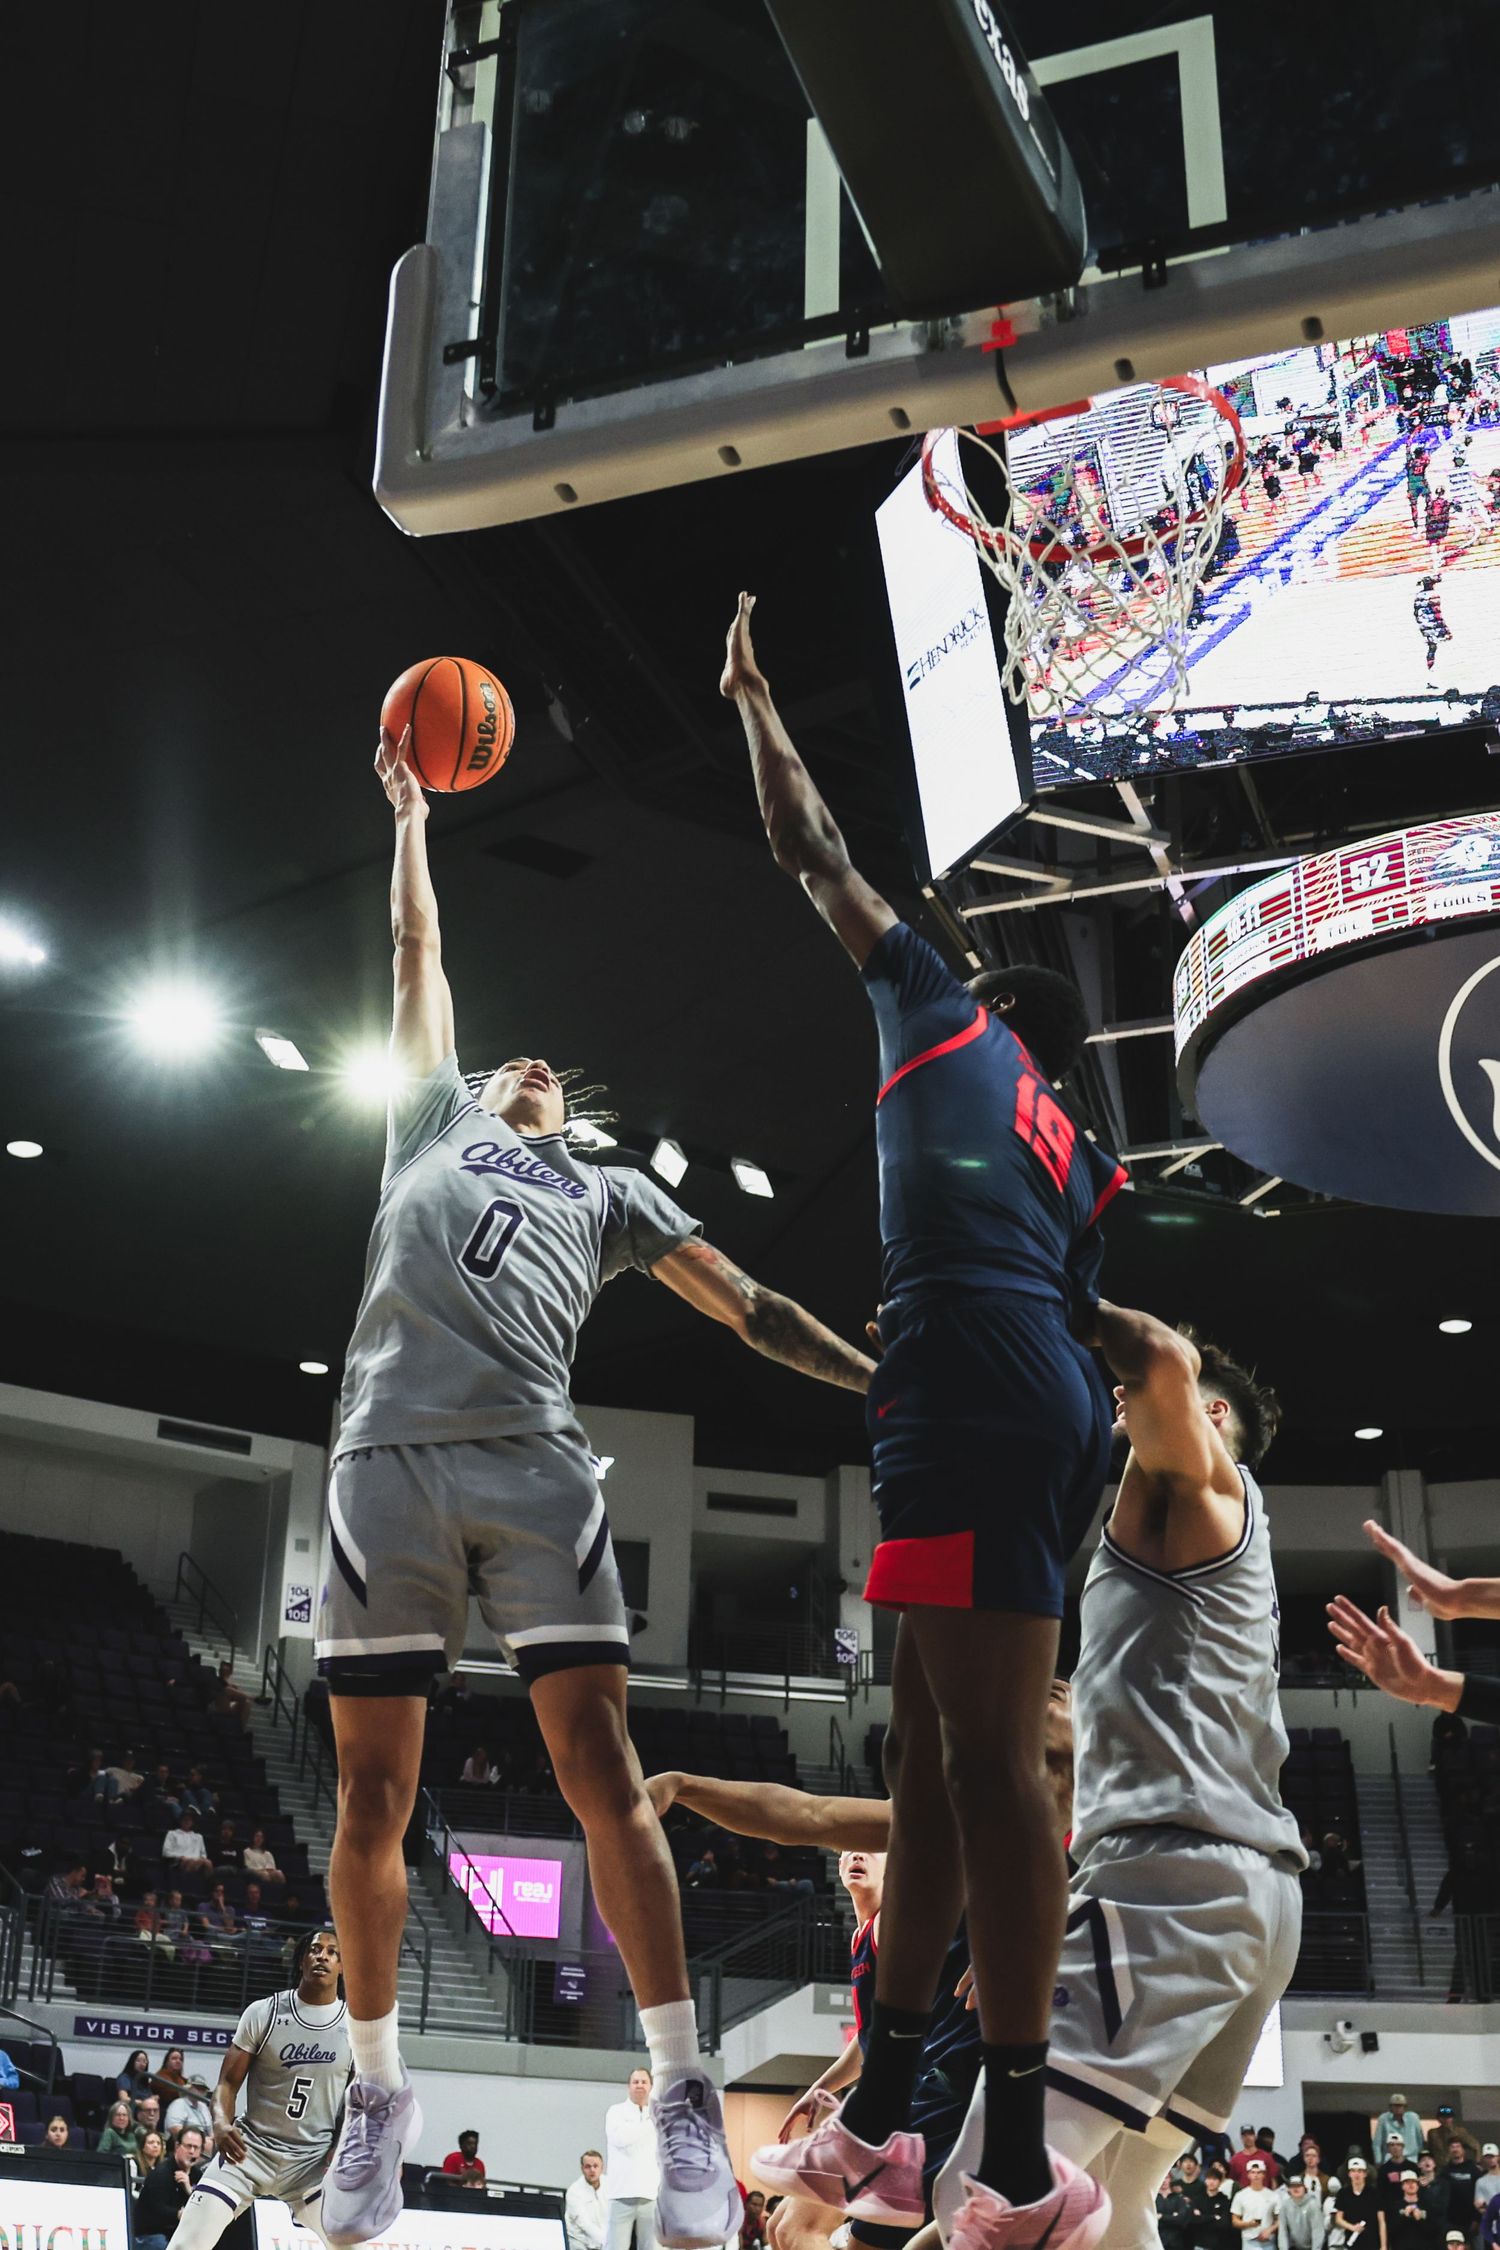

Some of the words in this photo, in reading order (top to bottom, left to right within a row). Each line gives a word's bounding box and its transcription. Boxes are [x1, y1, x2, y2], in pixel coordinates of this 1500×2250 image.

[974, 0, 1030, 121] exas
[919, 606, 985, 678] HENDRICK
[466, 682, 497, 771] Wilson
[1350, 852, 1391, 892] 52
[1433, 894, 1487, 910] FOULS
[460, 1141, 588, 1199] Abilene
[457, 1196, 528, 1282] 0
[291, 1586, 310, 1597] 104
[287, 1609, 309, 1622] 105
[86, 2021, 175, 2040] VISITOR
[186, 2030, 236, 2045] SEC
[279, 2043, 337, 2068] Abilene
[285, 2076, 315, 2121] 5
